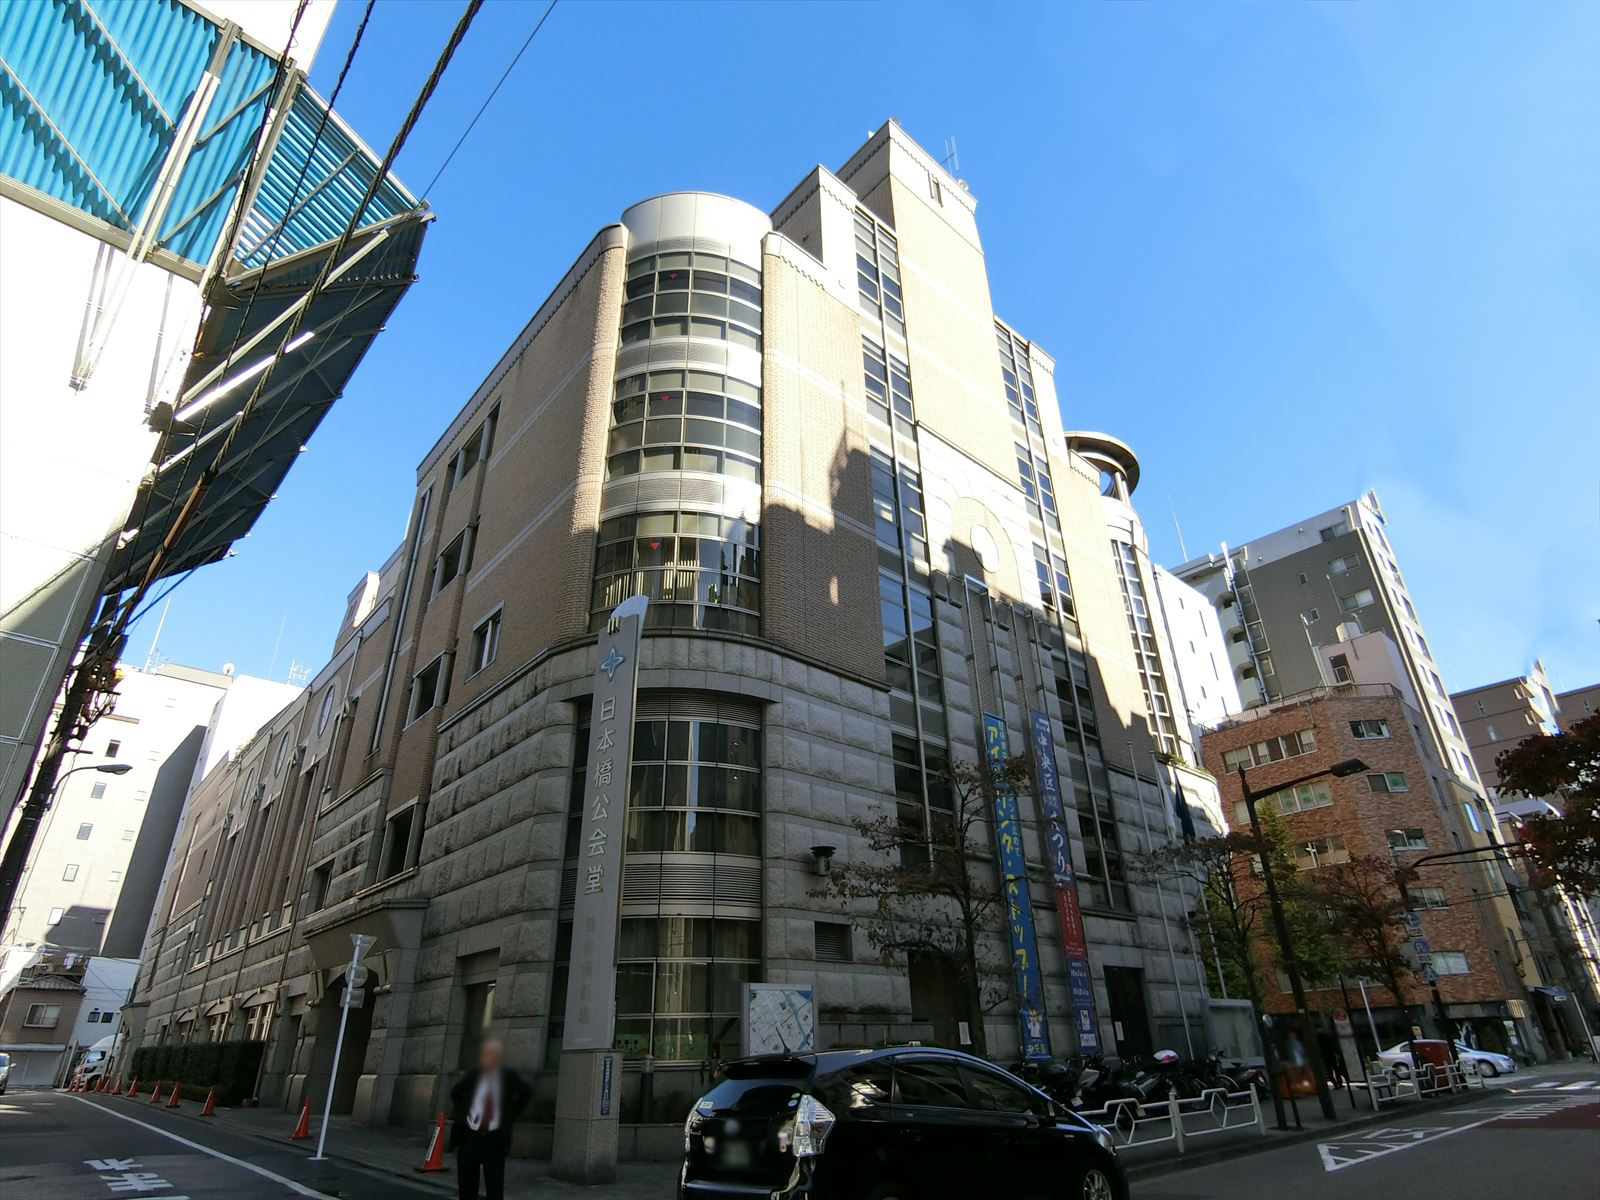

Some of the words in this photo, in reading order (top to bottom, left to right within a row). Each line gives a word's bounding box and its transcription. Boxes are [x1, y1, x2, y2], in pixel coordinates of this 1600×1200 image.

[583, 696, 617, 896] 日本橋公会堂
